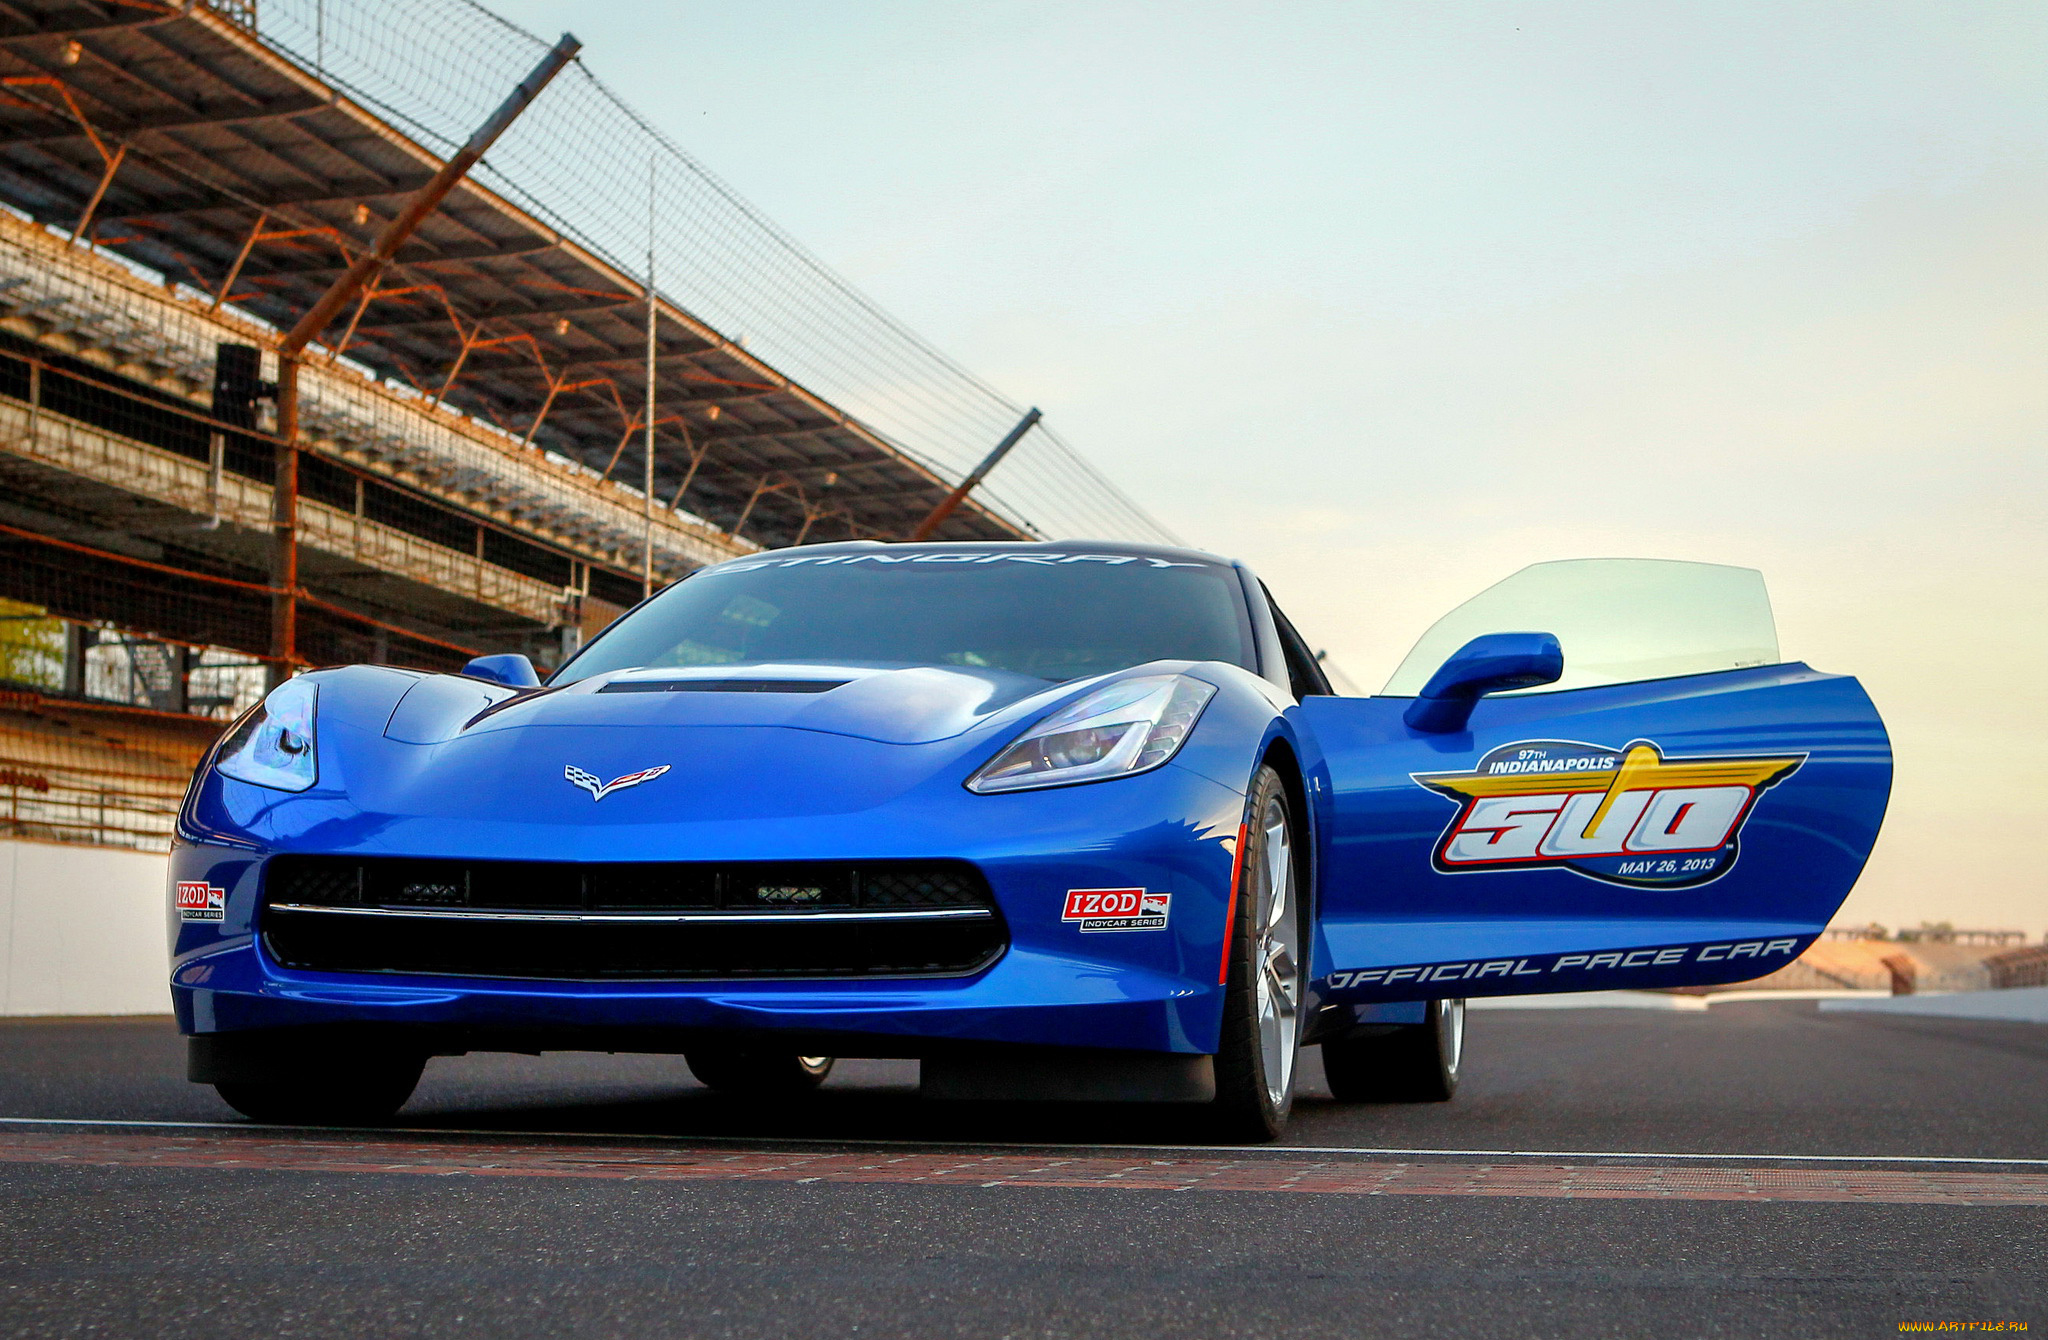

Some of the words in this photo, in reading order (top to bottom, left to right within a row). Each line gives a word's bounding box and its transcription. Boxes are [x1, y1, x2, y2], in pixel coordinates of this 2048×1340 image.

[699, 553, 1209, 578] STINGRAY
[1518, 750, 1547, 760] 97TH
[1489, 756, 1615, 774] INDIANAPOLIS
[1618, 861, 1656, 874] MAY
[1656, 860, 1677, 873] 26,
[1681, 858, 1716, 871] 2013
[178, 886, 205, 904] IZOD
[1071, 893, 1137, 914] IZOD
[1131, 918, 1164, 926] SERIES
[1327, 959, 1542, 990] OFFICIAL
[1551, 948, 1689, 973] PACE
[1696, 938, 1798, 962] CAR
